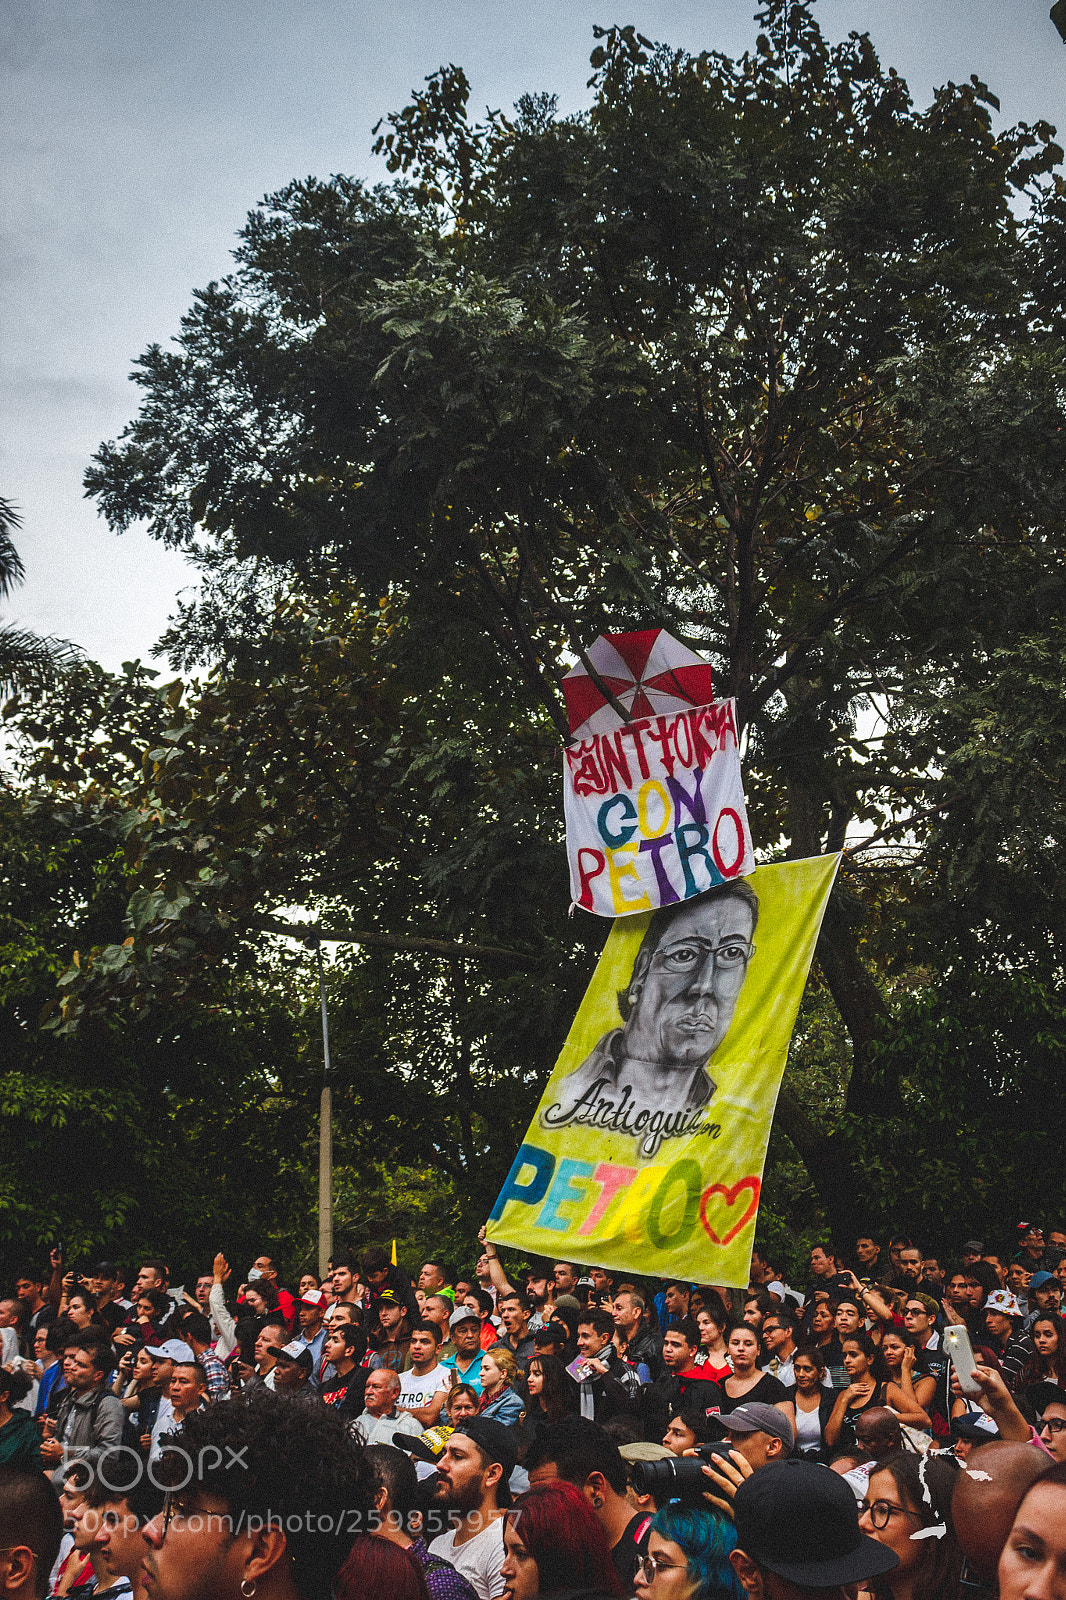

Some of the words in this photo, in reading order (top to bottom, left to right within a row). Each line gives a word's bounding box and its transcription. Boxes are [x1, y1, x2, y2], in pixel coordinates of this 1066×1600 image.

[577, 808, 746, 914] PETRO
[597, 767, 709, 850] CON
[488, 1143, 702, 1250] PETRO
